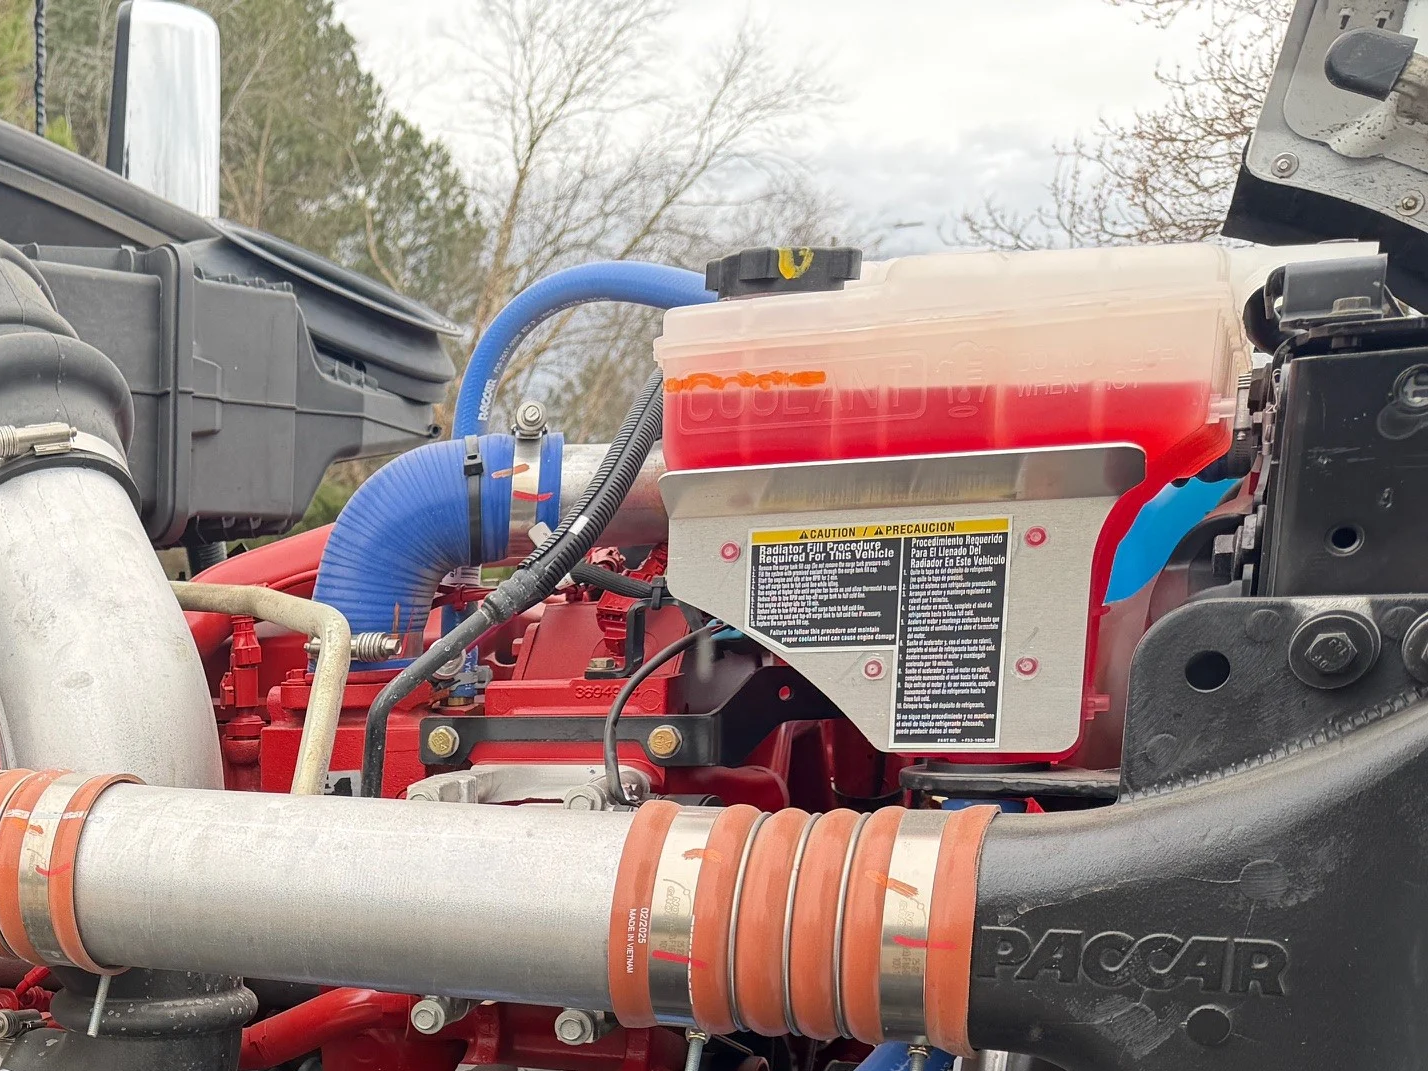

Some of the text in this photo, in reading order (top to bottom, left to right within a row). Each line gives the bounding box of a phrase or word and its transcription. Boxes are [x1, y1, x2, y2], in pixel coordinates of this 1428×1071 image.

[684, 364, 918, 423] COOLANT
[1016, 375, 1080, 398] WHEN
[477, 379, 496, 420] PACCAR
[810, 527, 855, 538] CAUTION
[885, 522, 954, 534] PRECAUCION
[965, 533, 1002, 545] Requerido
[758, 548, 894, 565] Required For This Vehicle
[759, 540, 880, 555] Radiator Fill Procedure
[911, 545, 981, 557] Para El Llenado Del
[638, 907, 650, 944] 02/2025
[626, 908, 637, 974] MADE IN VIETNAM
[976, 925, 1290, 996] PACCAR
